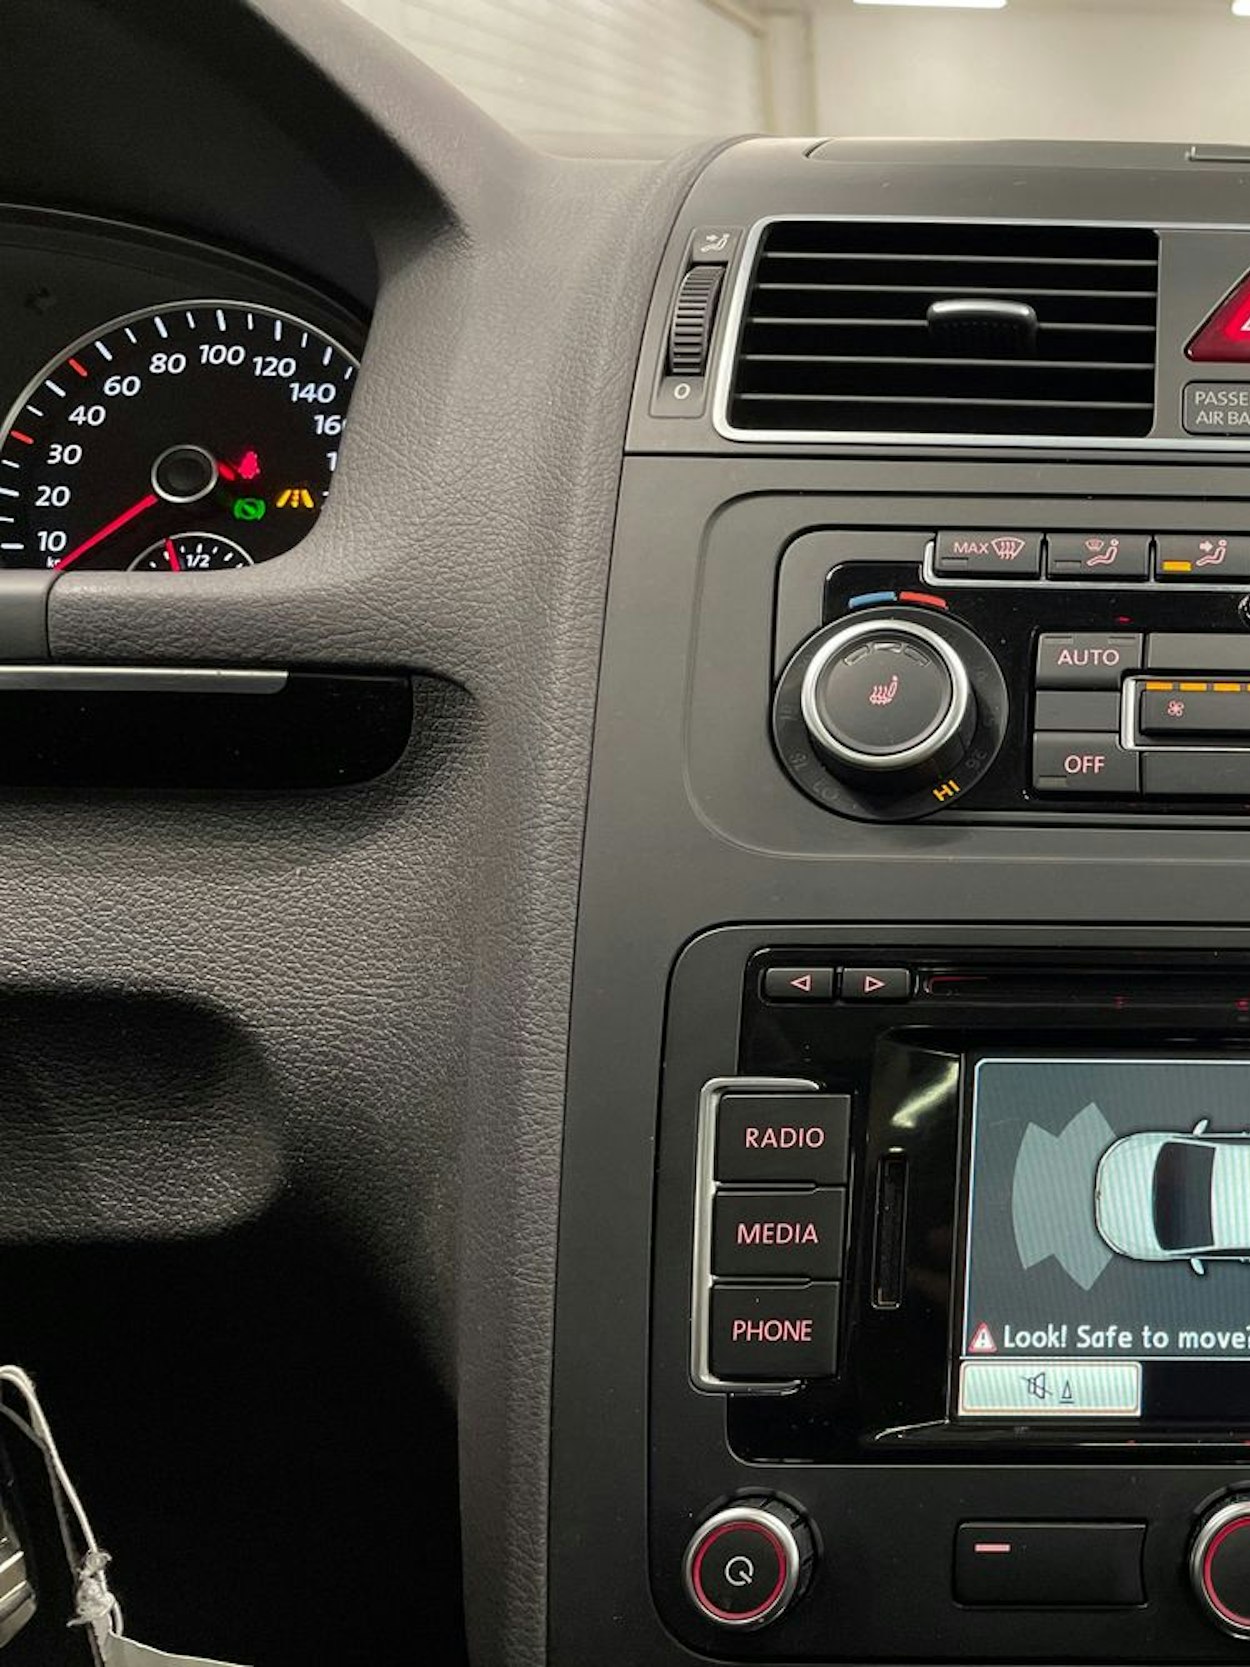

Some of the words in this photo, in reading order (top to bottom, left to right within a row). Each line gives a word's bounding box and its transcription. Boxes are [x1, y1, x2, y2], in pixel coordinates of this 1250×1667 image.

[149, 352, 187, 374] 80
[199, 344, 246, 366] 100
[252, 356, 297, 378] 120
[103, 375, 141, 397] 60
[289, 382, 336, 404] 140
[68, 405, 106, 427] 40
[314, 414, 347, 435] 16
[1195, 410, 1224, 426] AIR
[47, 443, 83, 465] 30
[35, 485, 71, 507] 20
[37, 530, 67, 552] 10
[953, 541, 989, 555] MAX
[186, 554, 210, 568] 1/2
[1057, 649, 1120, 666] AUTO
[1064, 755, 1105, 774] OFF
[933, 779, 961, 802] HI
[745, 1127, 825, 1148] RADIO
[737, 1223, 819, 1244] MEDIA
[732, 1319, 813, 1342] PHONE
[1004, 1323, 1068, 1348] Look!
[1076, 1325, 1133, 1349] Safe
[1141, 1326, 1170, 1349] to
